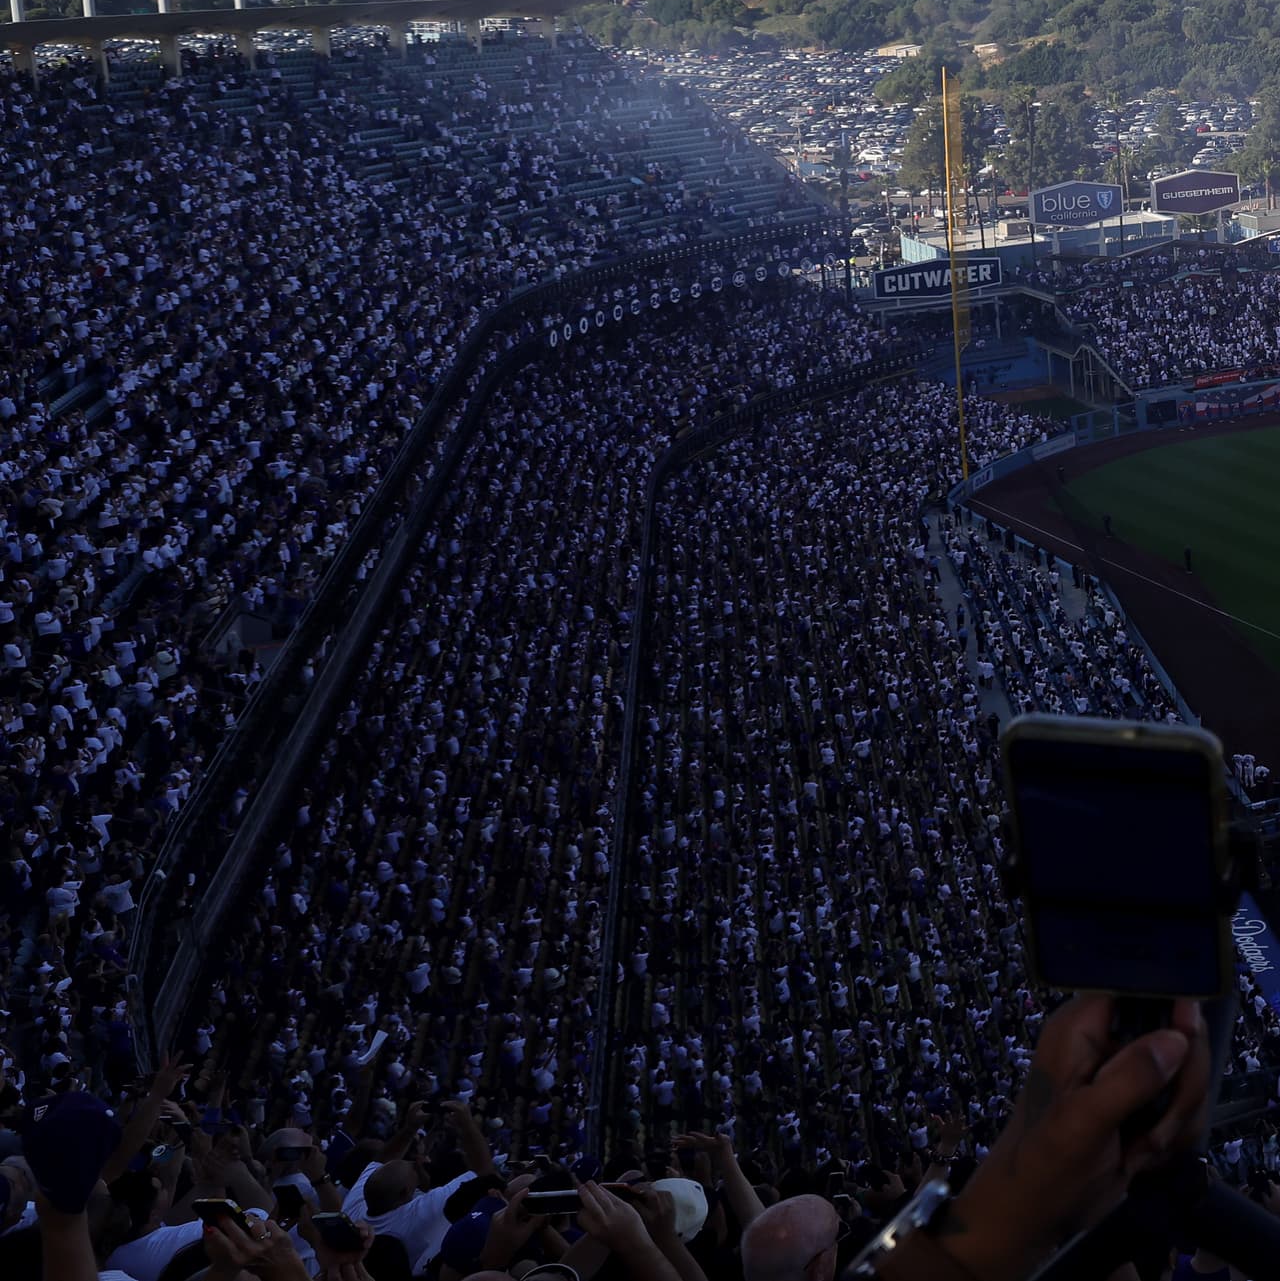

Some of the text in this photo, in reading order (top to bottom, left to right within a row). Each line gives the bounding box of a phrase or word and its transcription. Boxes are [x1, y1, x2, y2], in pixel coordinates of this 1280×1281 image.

[1042, 193, 1091, 212] blue
[1162, 186, 1234, 200] GUGGENHEIM
[1050, 209, 1097, 222] california
[884, 264, 992, 293] CUTWATER
[1231, 919, 1276, 973] Dodgers
